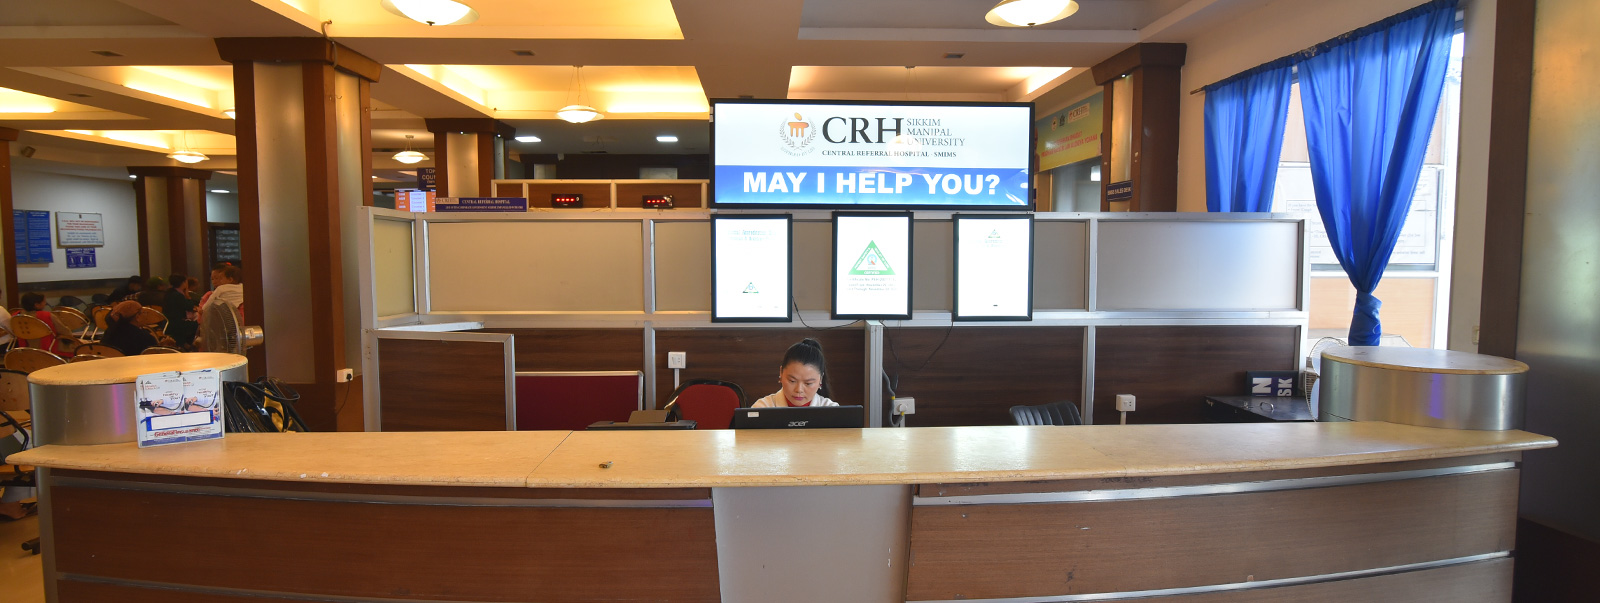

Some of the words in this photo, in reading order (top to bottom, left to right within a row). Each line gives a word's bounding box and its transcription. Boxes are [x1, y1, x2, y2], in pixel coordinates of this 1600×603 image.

[906, 118, 940, 126] SIKKIM
[822, 116, 904, 144] CRH
[906, 128, 952, 136] MANIPAL
[906, 138, 965, 146] UNIVERSITY
[743, 172, 807, 193] MAY
[817, 172, 825, 193] I
[836, 173, 912, 194] HELP
[922, 174, 1000, 195] YOU?
